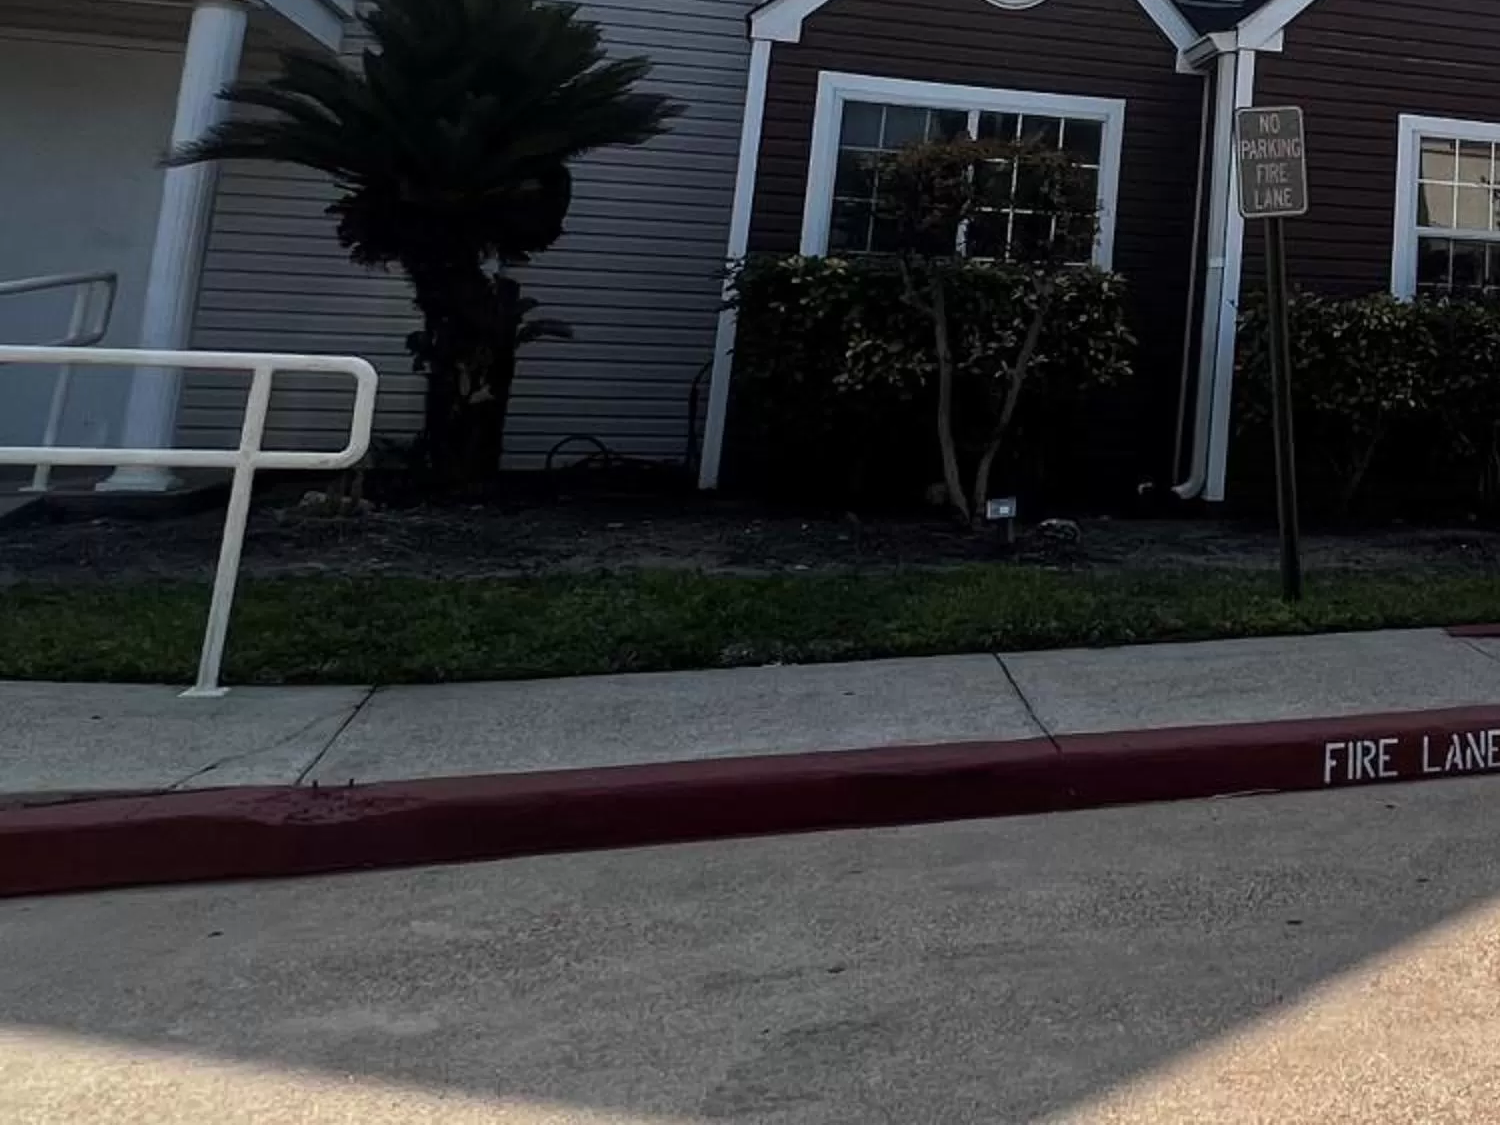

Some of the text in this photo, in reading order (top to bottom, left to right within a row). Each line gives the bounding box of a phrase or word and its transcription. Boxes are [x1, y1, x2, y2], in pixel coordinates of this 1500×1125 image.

[1259, 113, 1280, 134] NO
[1241, 138, 1301, 160] PARKING
[1256, 162, 1289, 184] FIRE
[1255, 187, 1293, 210] LANE
[1324, 738, 1399, 783] FIRE
